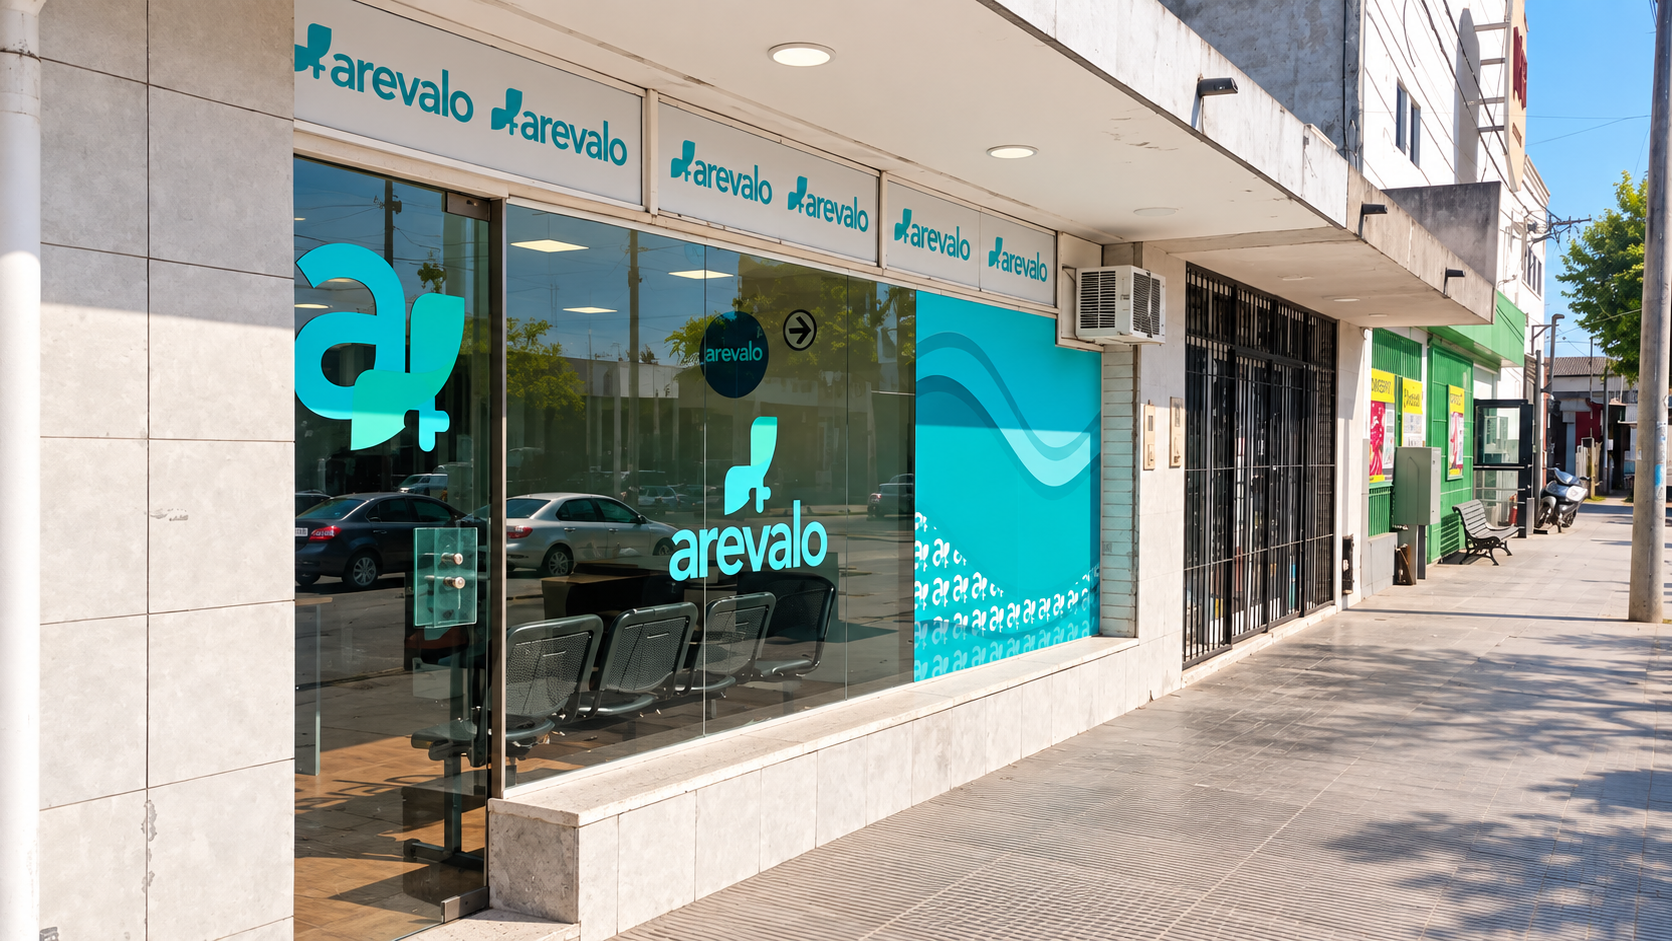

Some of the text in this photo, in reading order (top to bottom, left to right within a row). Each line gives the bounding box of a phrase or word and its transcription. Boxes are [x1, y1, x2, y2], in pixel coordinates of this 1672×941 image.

[331, 53, 474, 123] arevalo
[521, 110, 628, 167] arevalo
[693, 159, 774, 205] arevalo
[804, 193, 869, 233] arevalo
[910, 223, 971, 261] arevalo
[1002, 251, 1048, 283] arevalo
[705, 340, 763, 363] arevalo
[669, 499, 829, 582] arevalo
